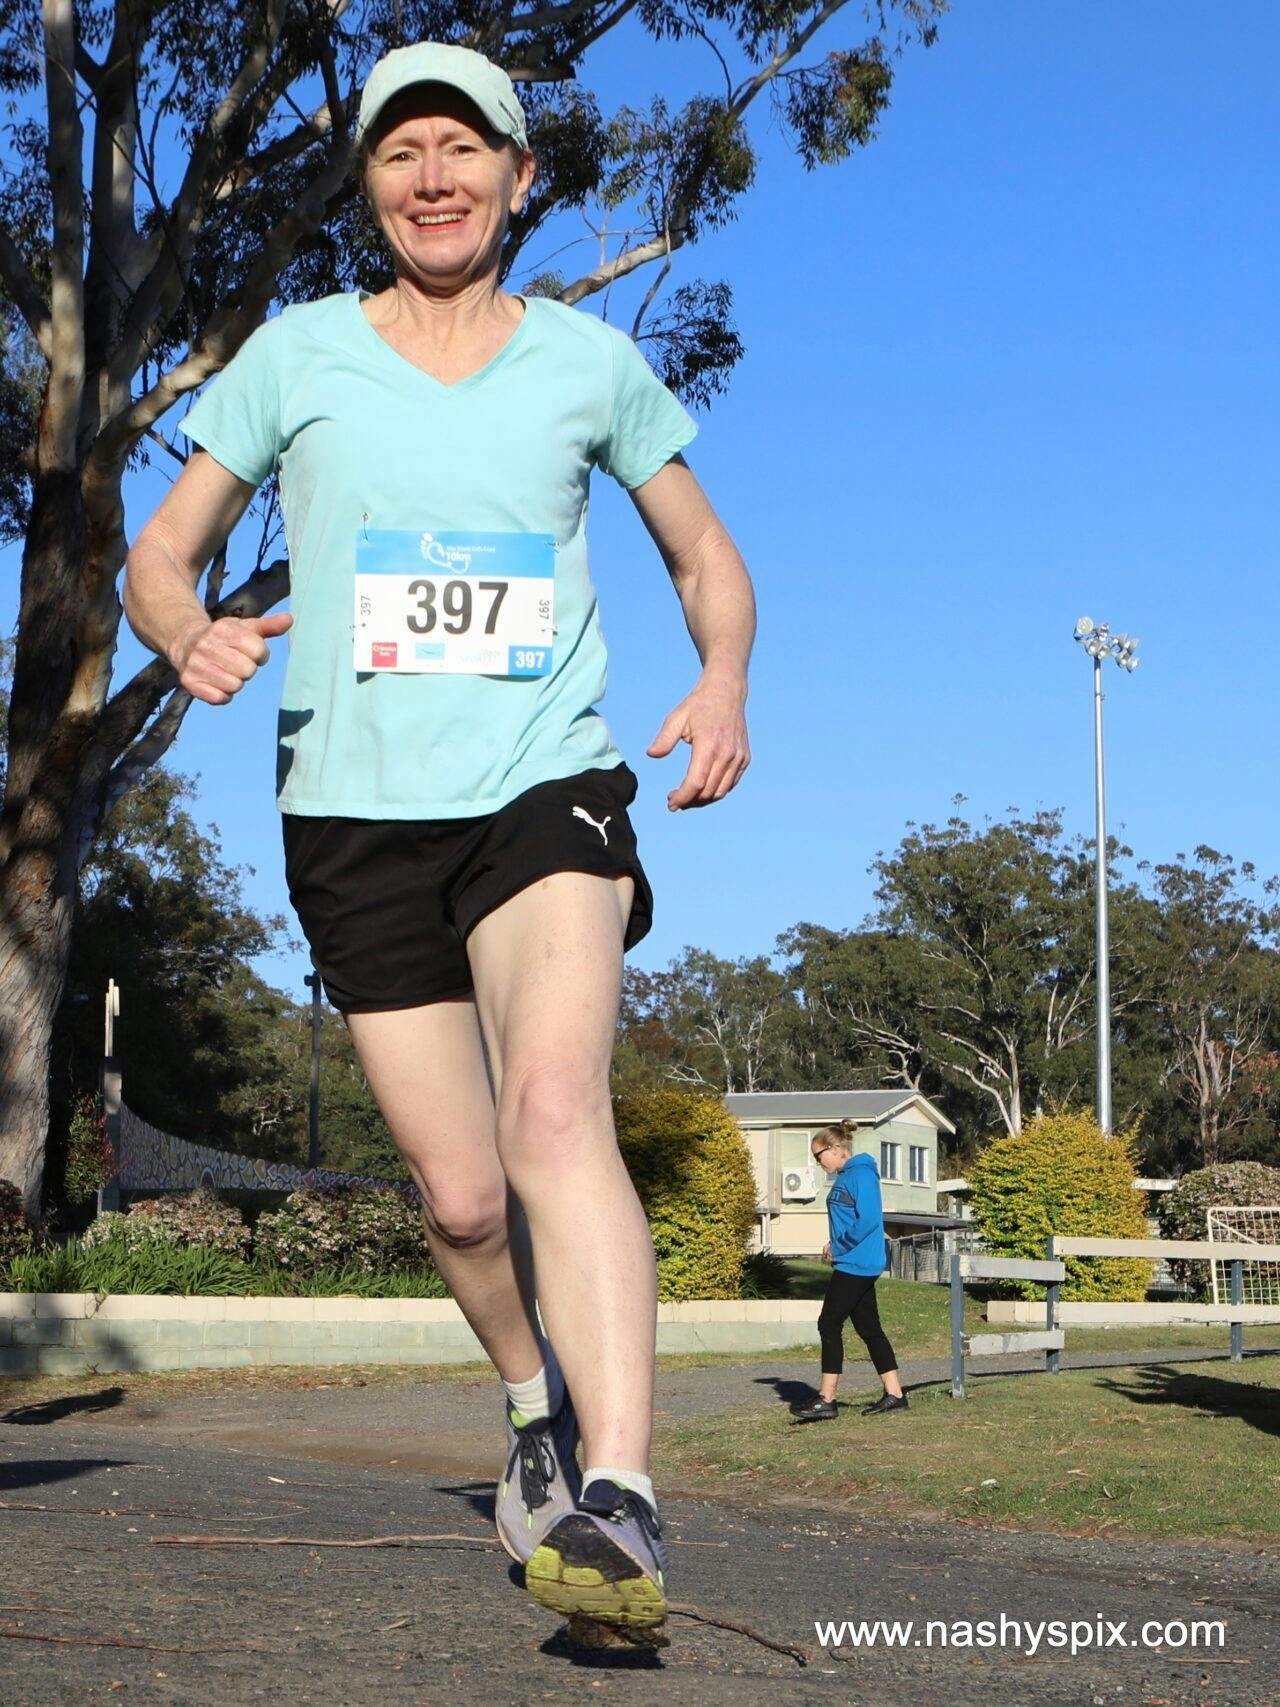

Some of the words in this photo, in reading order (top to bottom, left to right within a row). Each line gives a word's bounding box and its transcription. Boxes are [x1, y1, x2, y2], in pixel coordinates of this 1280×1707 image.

[360, 595, 372, 616] 397
[406, 579, 509, 635] 397
[538, 599, 550, 620] 397
[515, 651, 546, 669] 397
